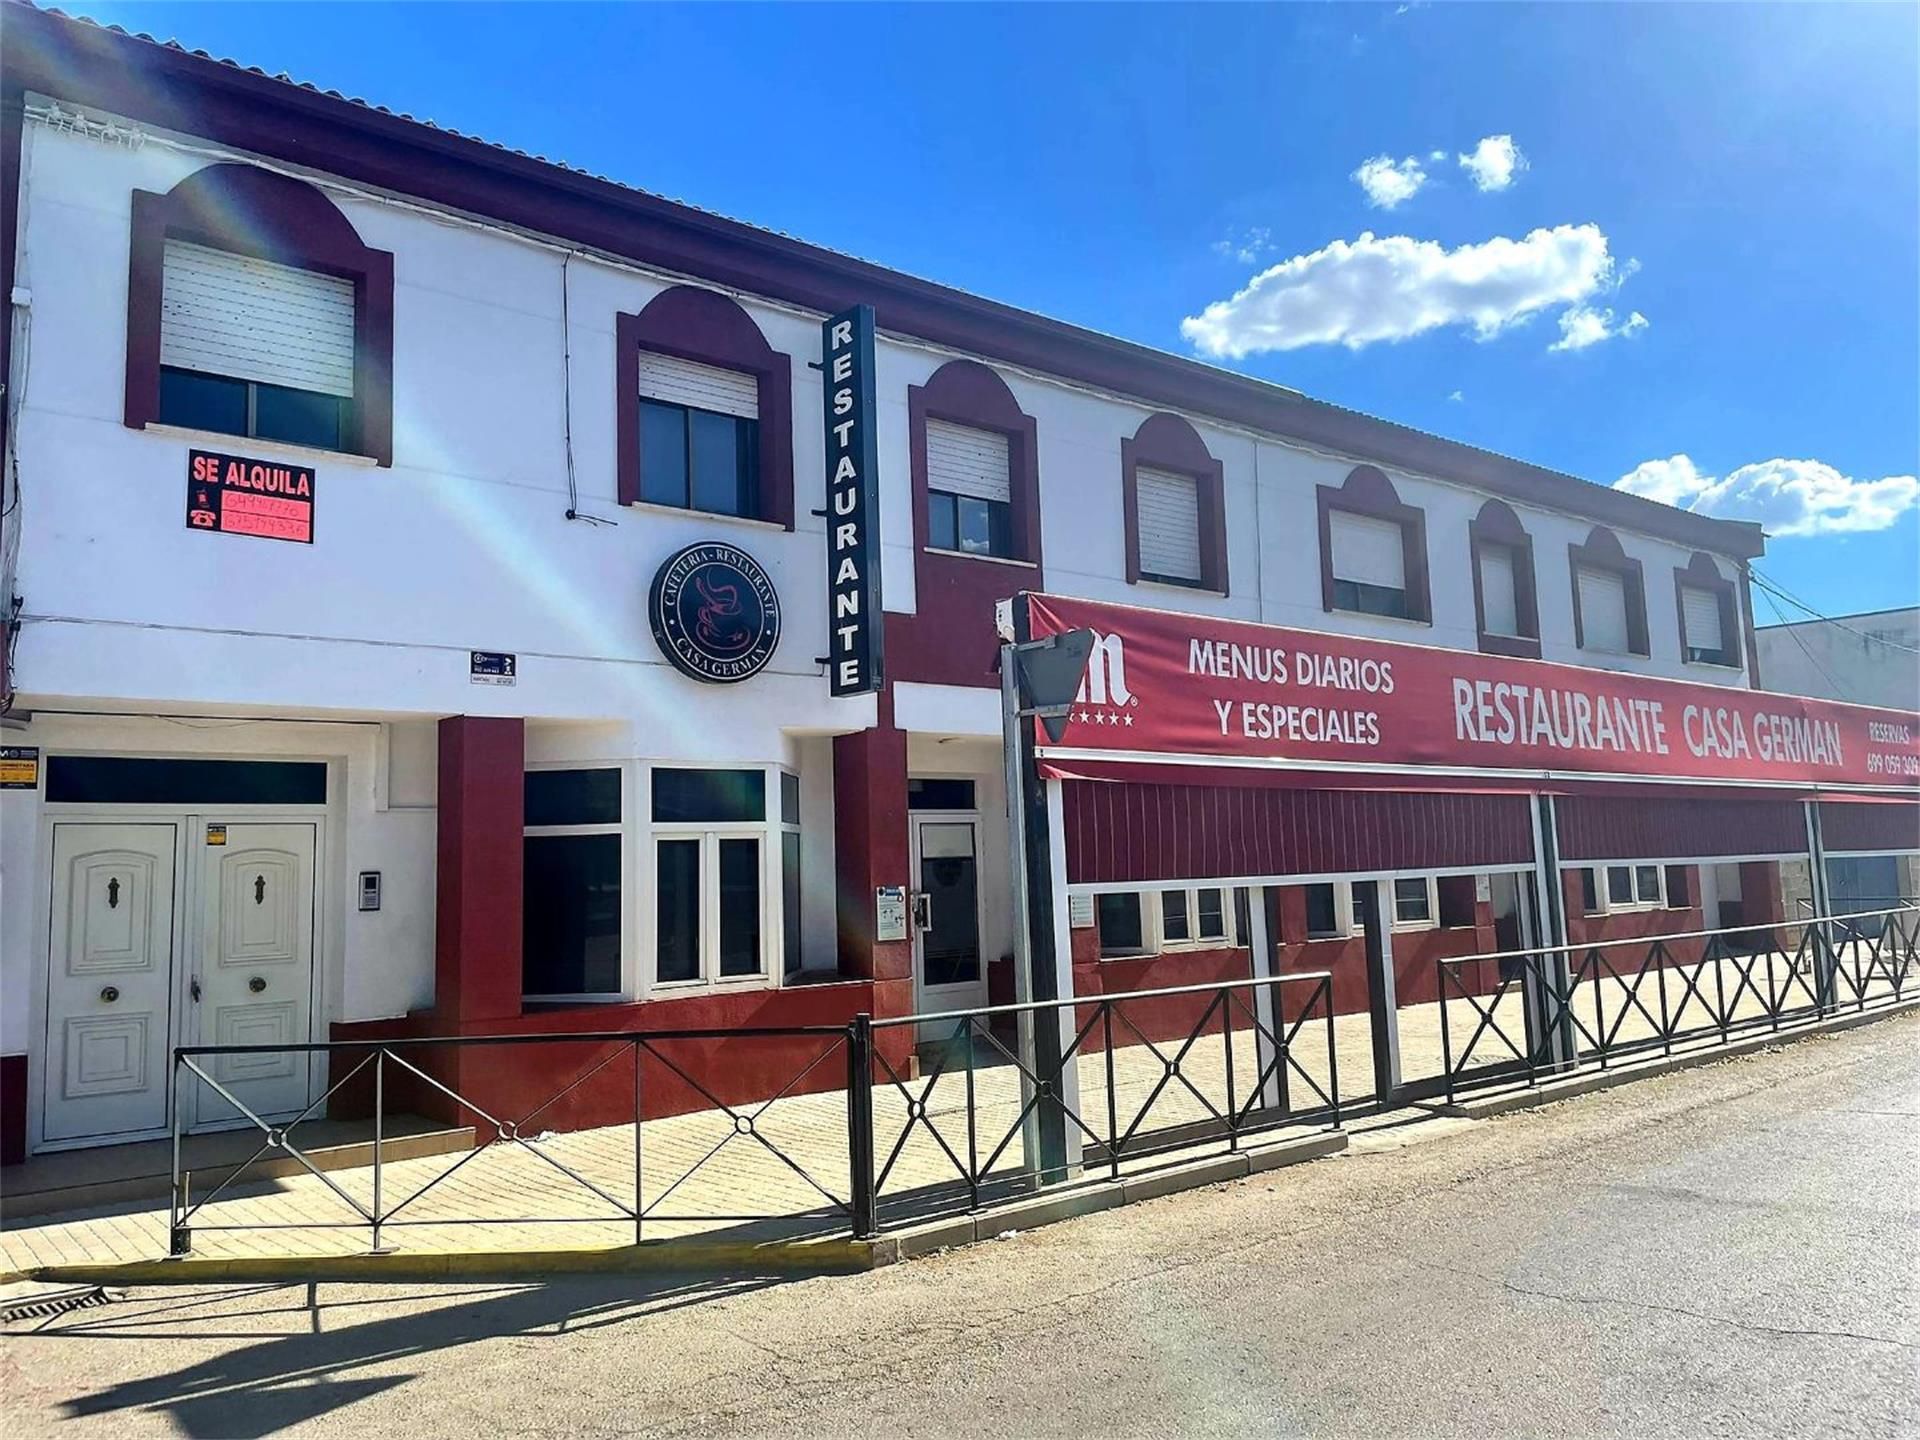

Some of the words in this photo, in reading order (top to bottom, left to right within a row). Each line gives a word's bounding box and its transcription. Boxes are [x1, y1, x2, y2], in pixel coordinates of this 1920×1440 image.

[193, 456, 219, 482] SE
[225, 462, 310, 497] ALQUILA
[831, 320, 859, 686] RESTAURANTE
[665, 551, 708, 606] CAFETERIA
[716, 549, 775, 618] RESTAURANTE
[677, 638, 708, 670] CASA
[711, 646, 766, 676] GERMAN
[1188, 638, 1288, 684] MENUS
[1296, 651, 1394, 694] DIARIOS
[1213, 699, 1233, 735] Y
[1242, 701, 1380, 745] ESPECIALES
[1452, 677, 1669, 754] RESTAURANTE
[1683, 705, 1752, 760] CASA
[1752, 712, 1843, 766] GERMAN
[1868, 722, 1910, 745] RESERVAS
[1867, 752, 1883, 773] 699
